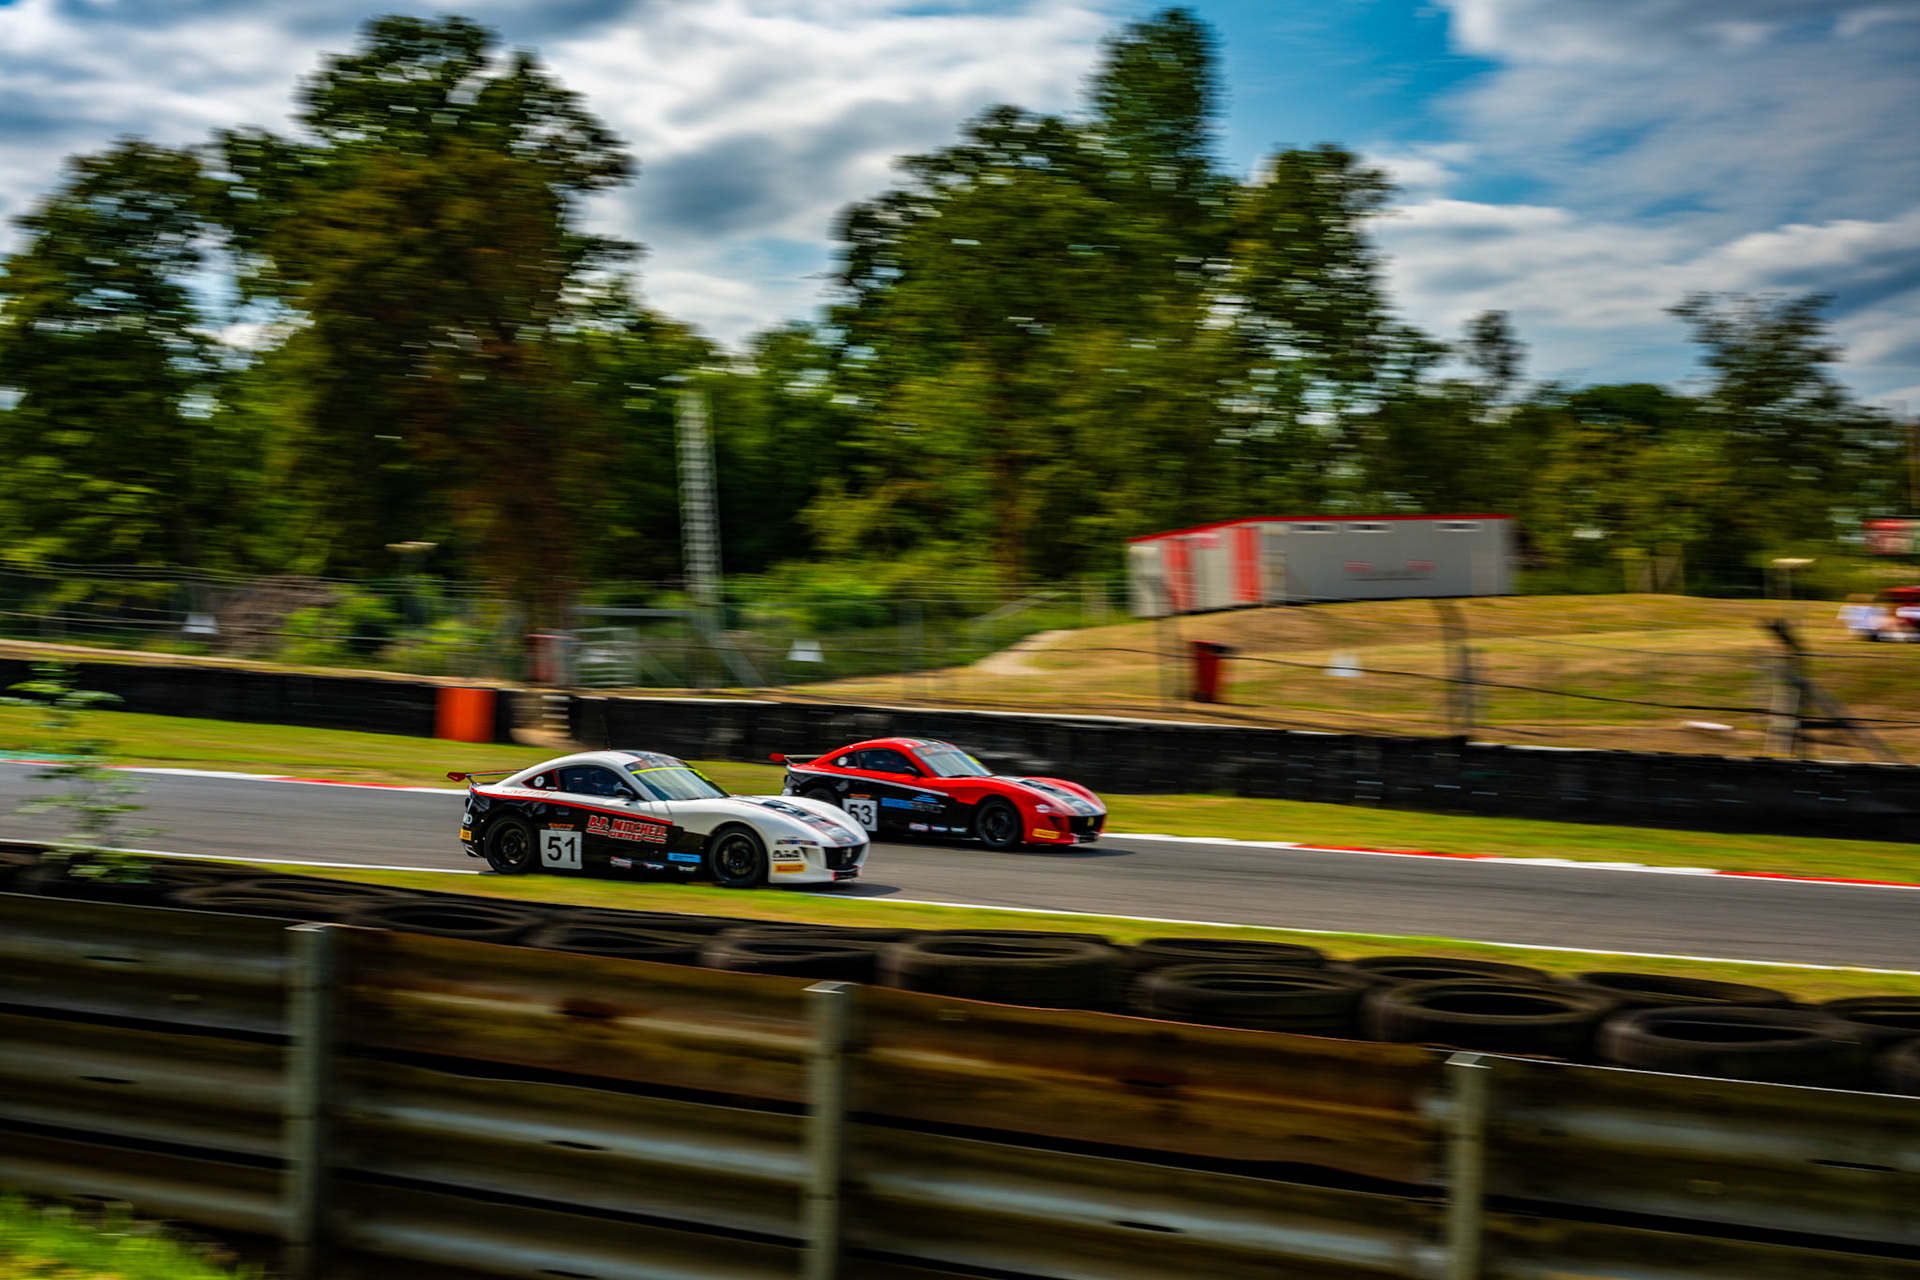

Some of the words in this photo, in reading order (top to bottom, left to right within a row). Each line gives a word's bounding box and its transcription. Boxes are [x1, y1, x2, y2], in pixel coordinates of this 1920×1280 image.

[848, 804, 872, 825] 53
[588, 815, 609, 830] B.P.
[611, 819, 668, 837] MITCHELL
[547, 836, 576, 862] 51
